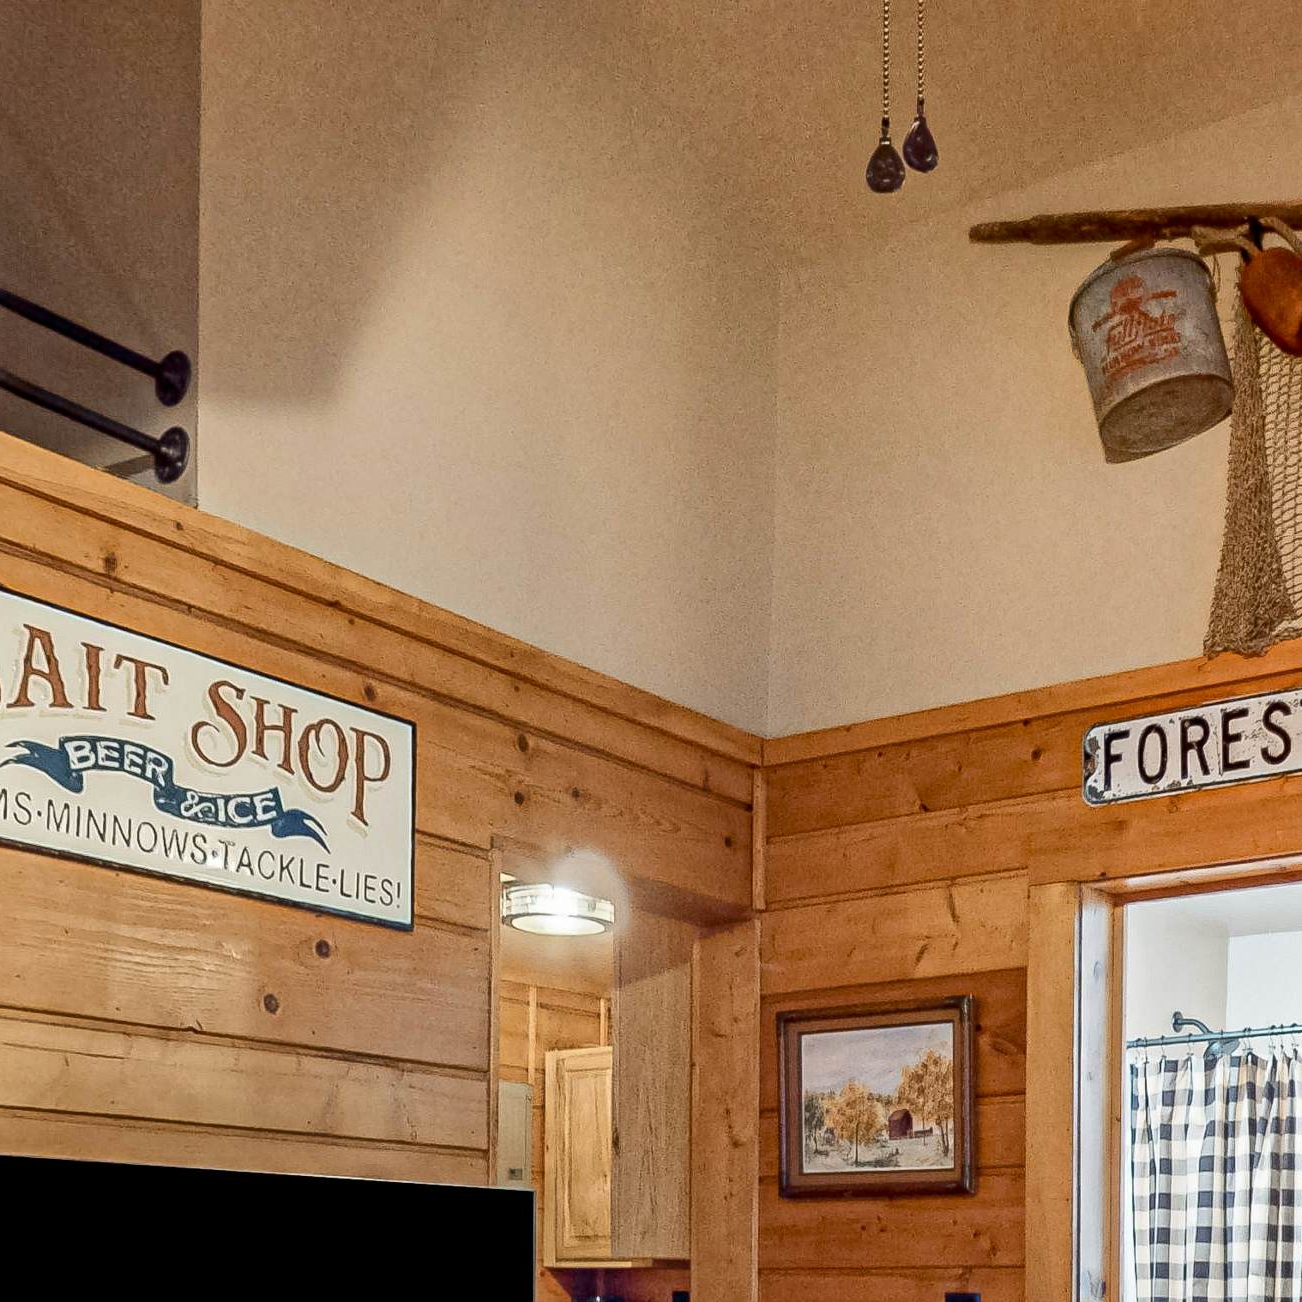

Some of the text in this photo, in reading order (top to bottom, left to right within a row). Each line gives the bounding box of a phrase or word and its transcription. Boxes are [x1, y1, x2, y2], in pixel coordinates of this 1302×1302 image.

[64, 739, 170, 786] BEER
[191, 680, 391, 826] SHOP
[215, 790, 278, 823] ICE
